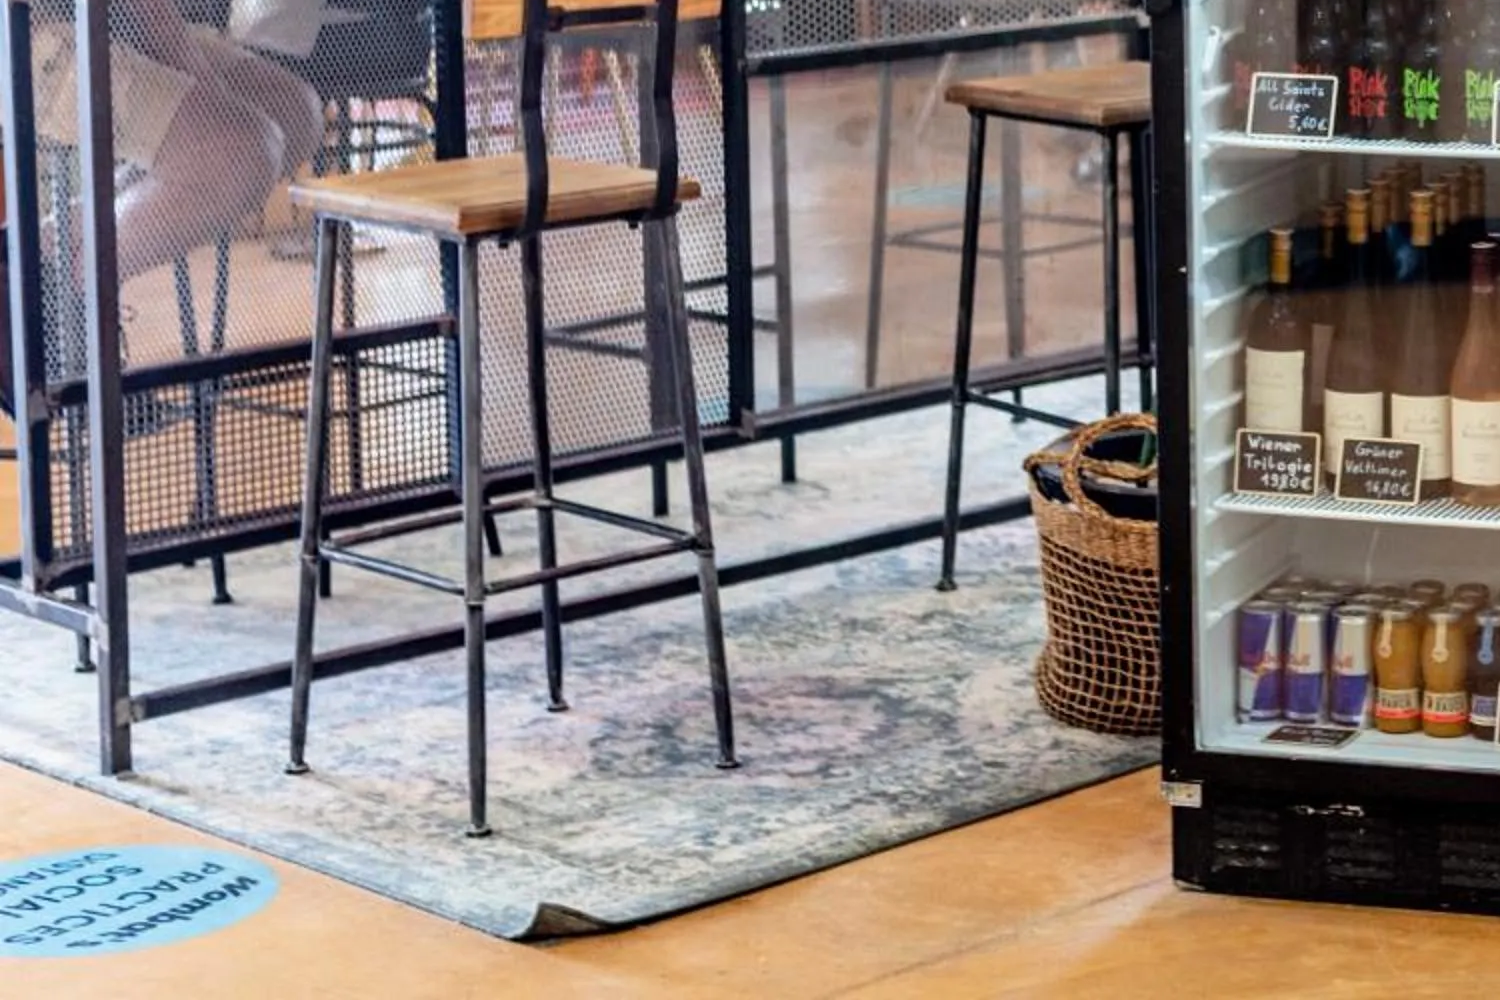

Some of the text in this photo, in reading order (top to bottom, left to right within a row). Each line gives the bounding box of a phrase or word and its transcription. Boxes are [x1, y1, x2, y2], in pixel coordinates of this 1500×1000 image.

[1257, 79, 1278, 93] All
[1268, 96, 1311, 112] Cider
[1247, 435, 1301, 453] Wiener
[1355, 441, 1403, 459] Grüner
[1244, 453, 1312, 477] Trilogie
[4, 861, 226, 945] PRACTICES
